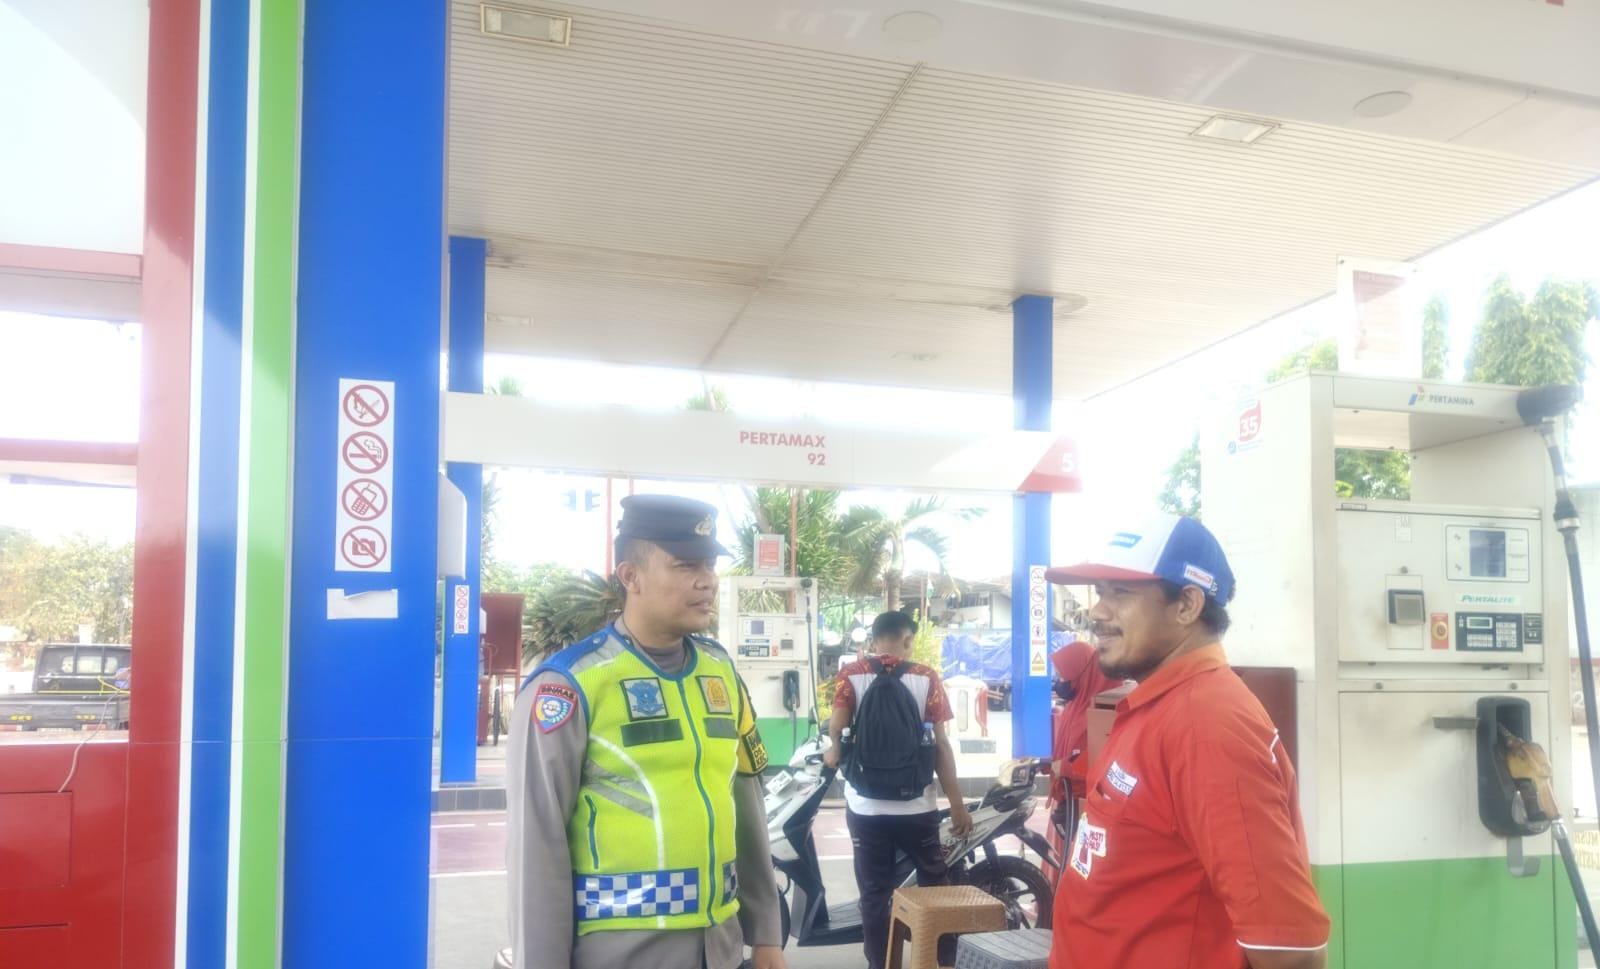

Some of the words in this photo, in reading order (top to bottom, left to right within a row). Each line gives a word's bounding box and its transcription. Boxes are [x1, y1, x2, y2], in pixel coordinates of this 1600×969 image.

[1429, 394, 1474, 407] PERTAMINA
[740, 431, 826, 448] PERTAMAX
[807, 452, 826, 466] 92
